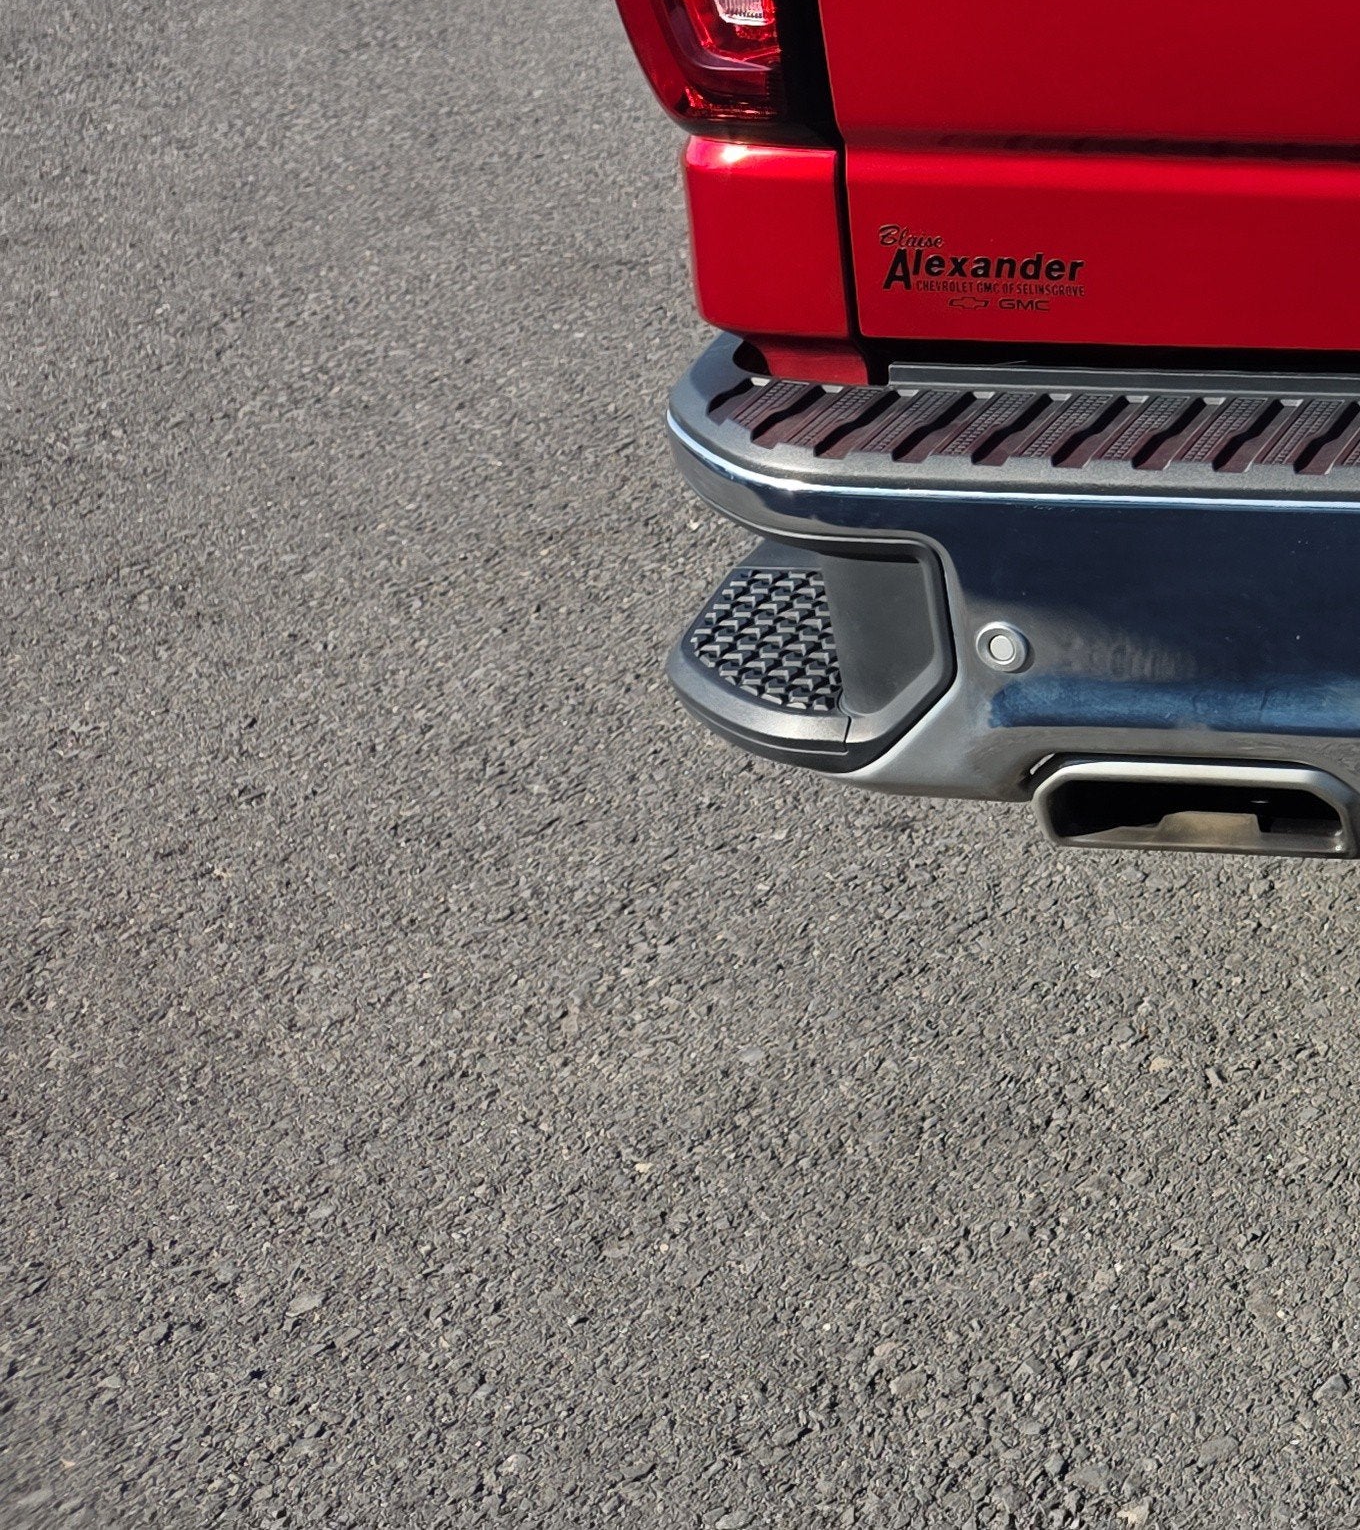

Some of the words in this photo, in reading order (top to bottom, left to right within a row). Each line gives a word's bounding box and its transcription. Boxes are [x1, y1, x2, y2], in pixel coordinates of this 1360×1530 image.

[879, 223, 944, 249] Blaise
[883, 248, 1085, 290] Alexander
[916, 279, 974, 293] CHEVROLET
[976, 280, 1000, 294] GMC
[1002, 281, 1015, 295] OF
[998, 297, 1050, 312] GMC
